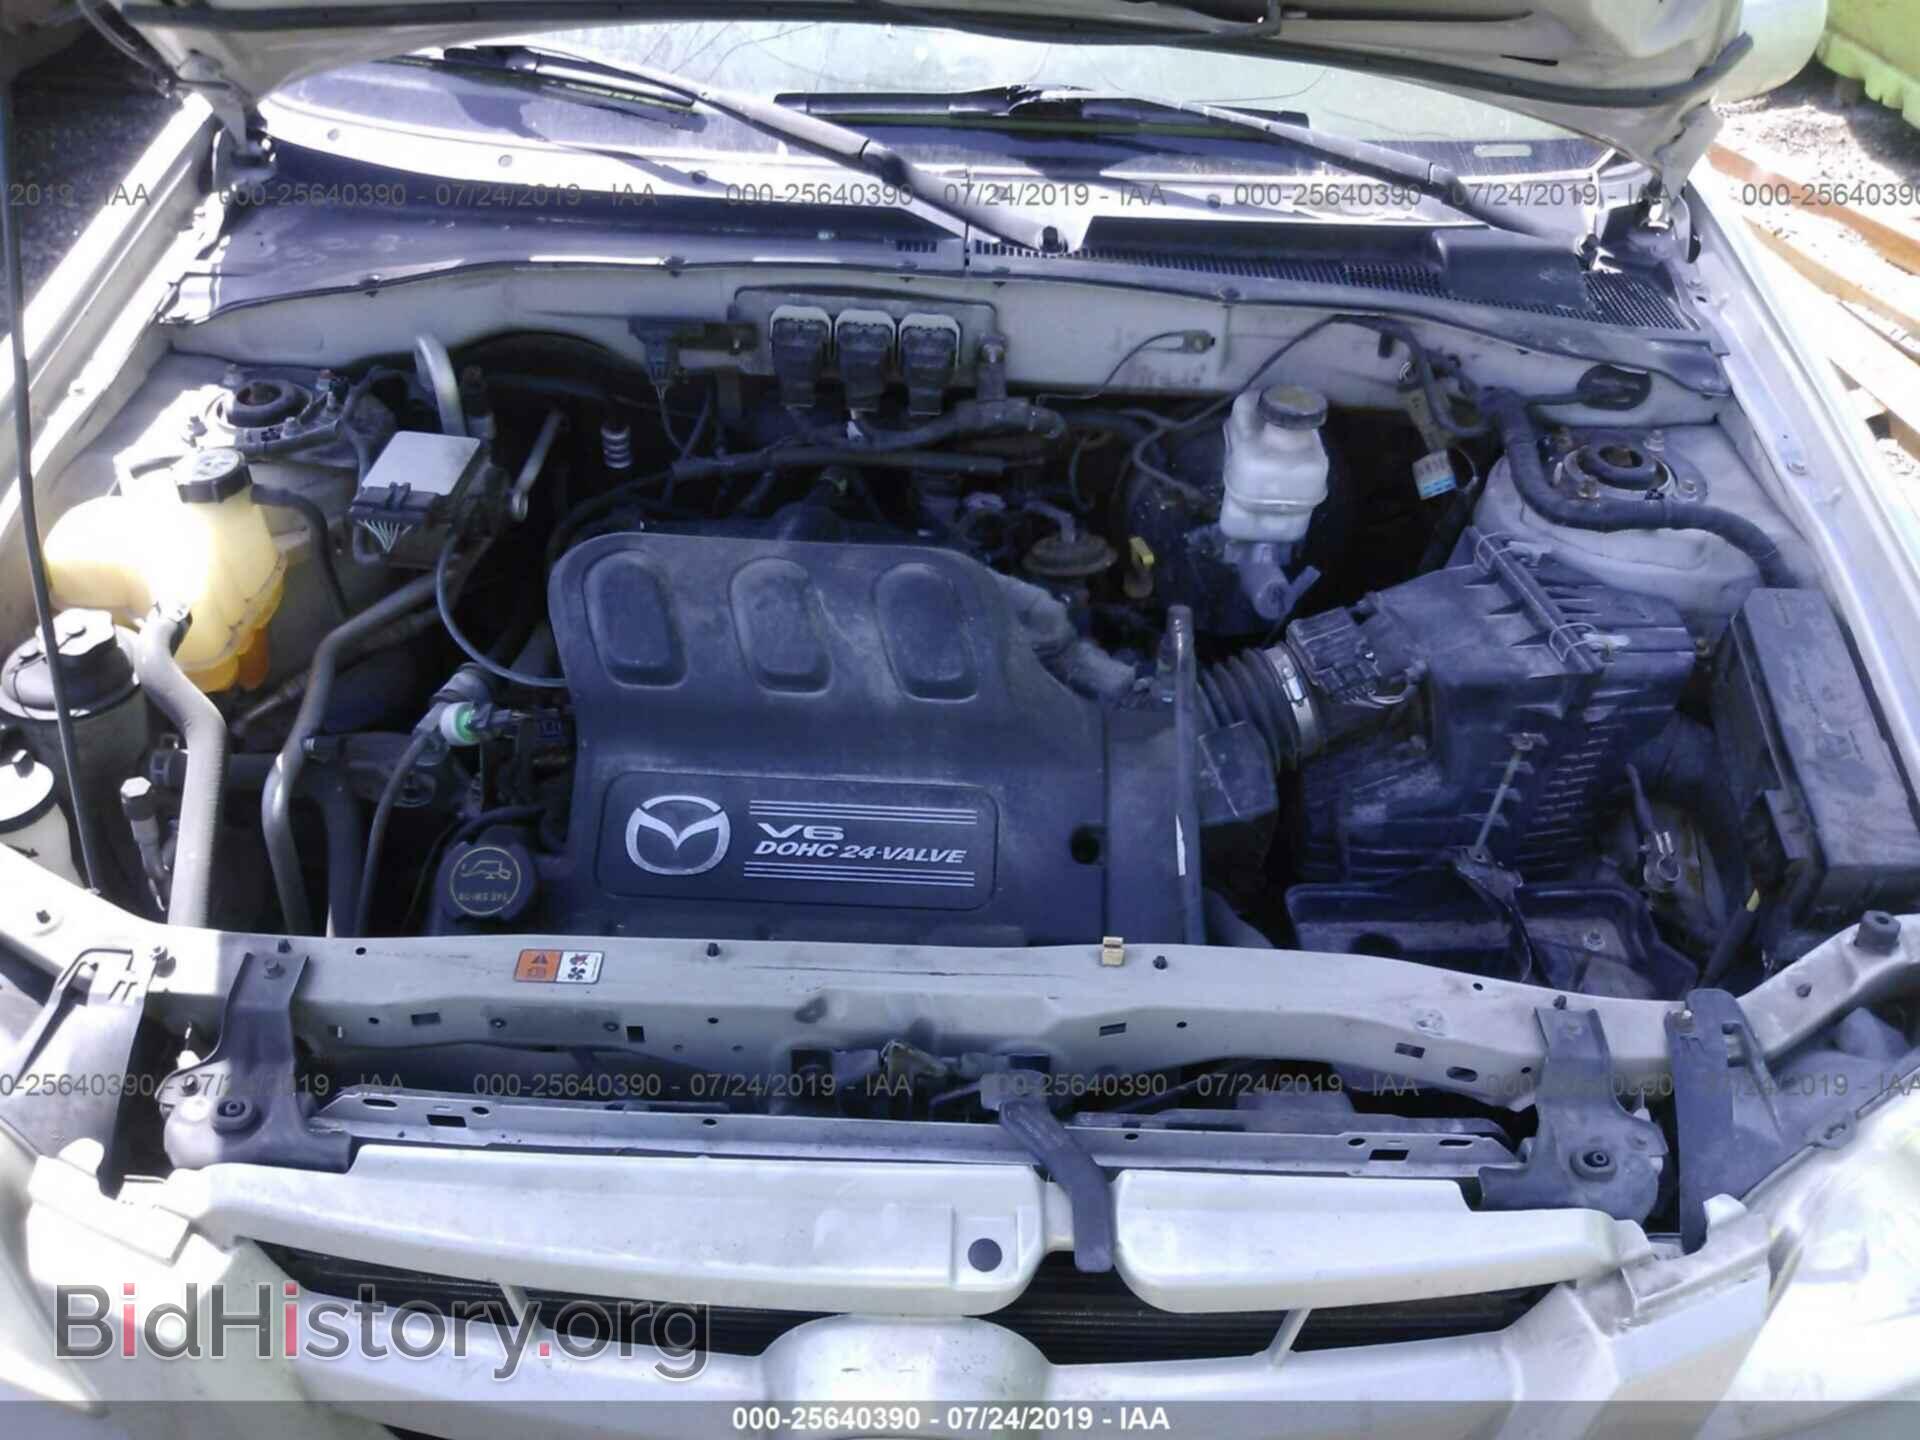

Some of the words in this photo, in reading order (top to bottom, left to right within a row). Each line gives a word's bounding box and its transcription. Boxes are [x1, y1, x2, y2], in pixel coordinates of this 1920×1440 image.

[757, 822, 845, 841] V6
[753, 840, 839, 858] DOHC
[839, 845, 968, 864] 24-VALVE
